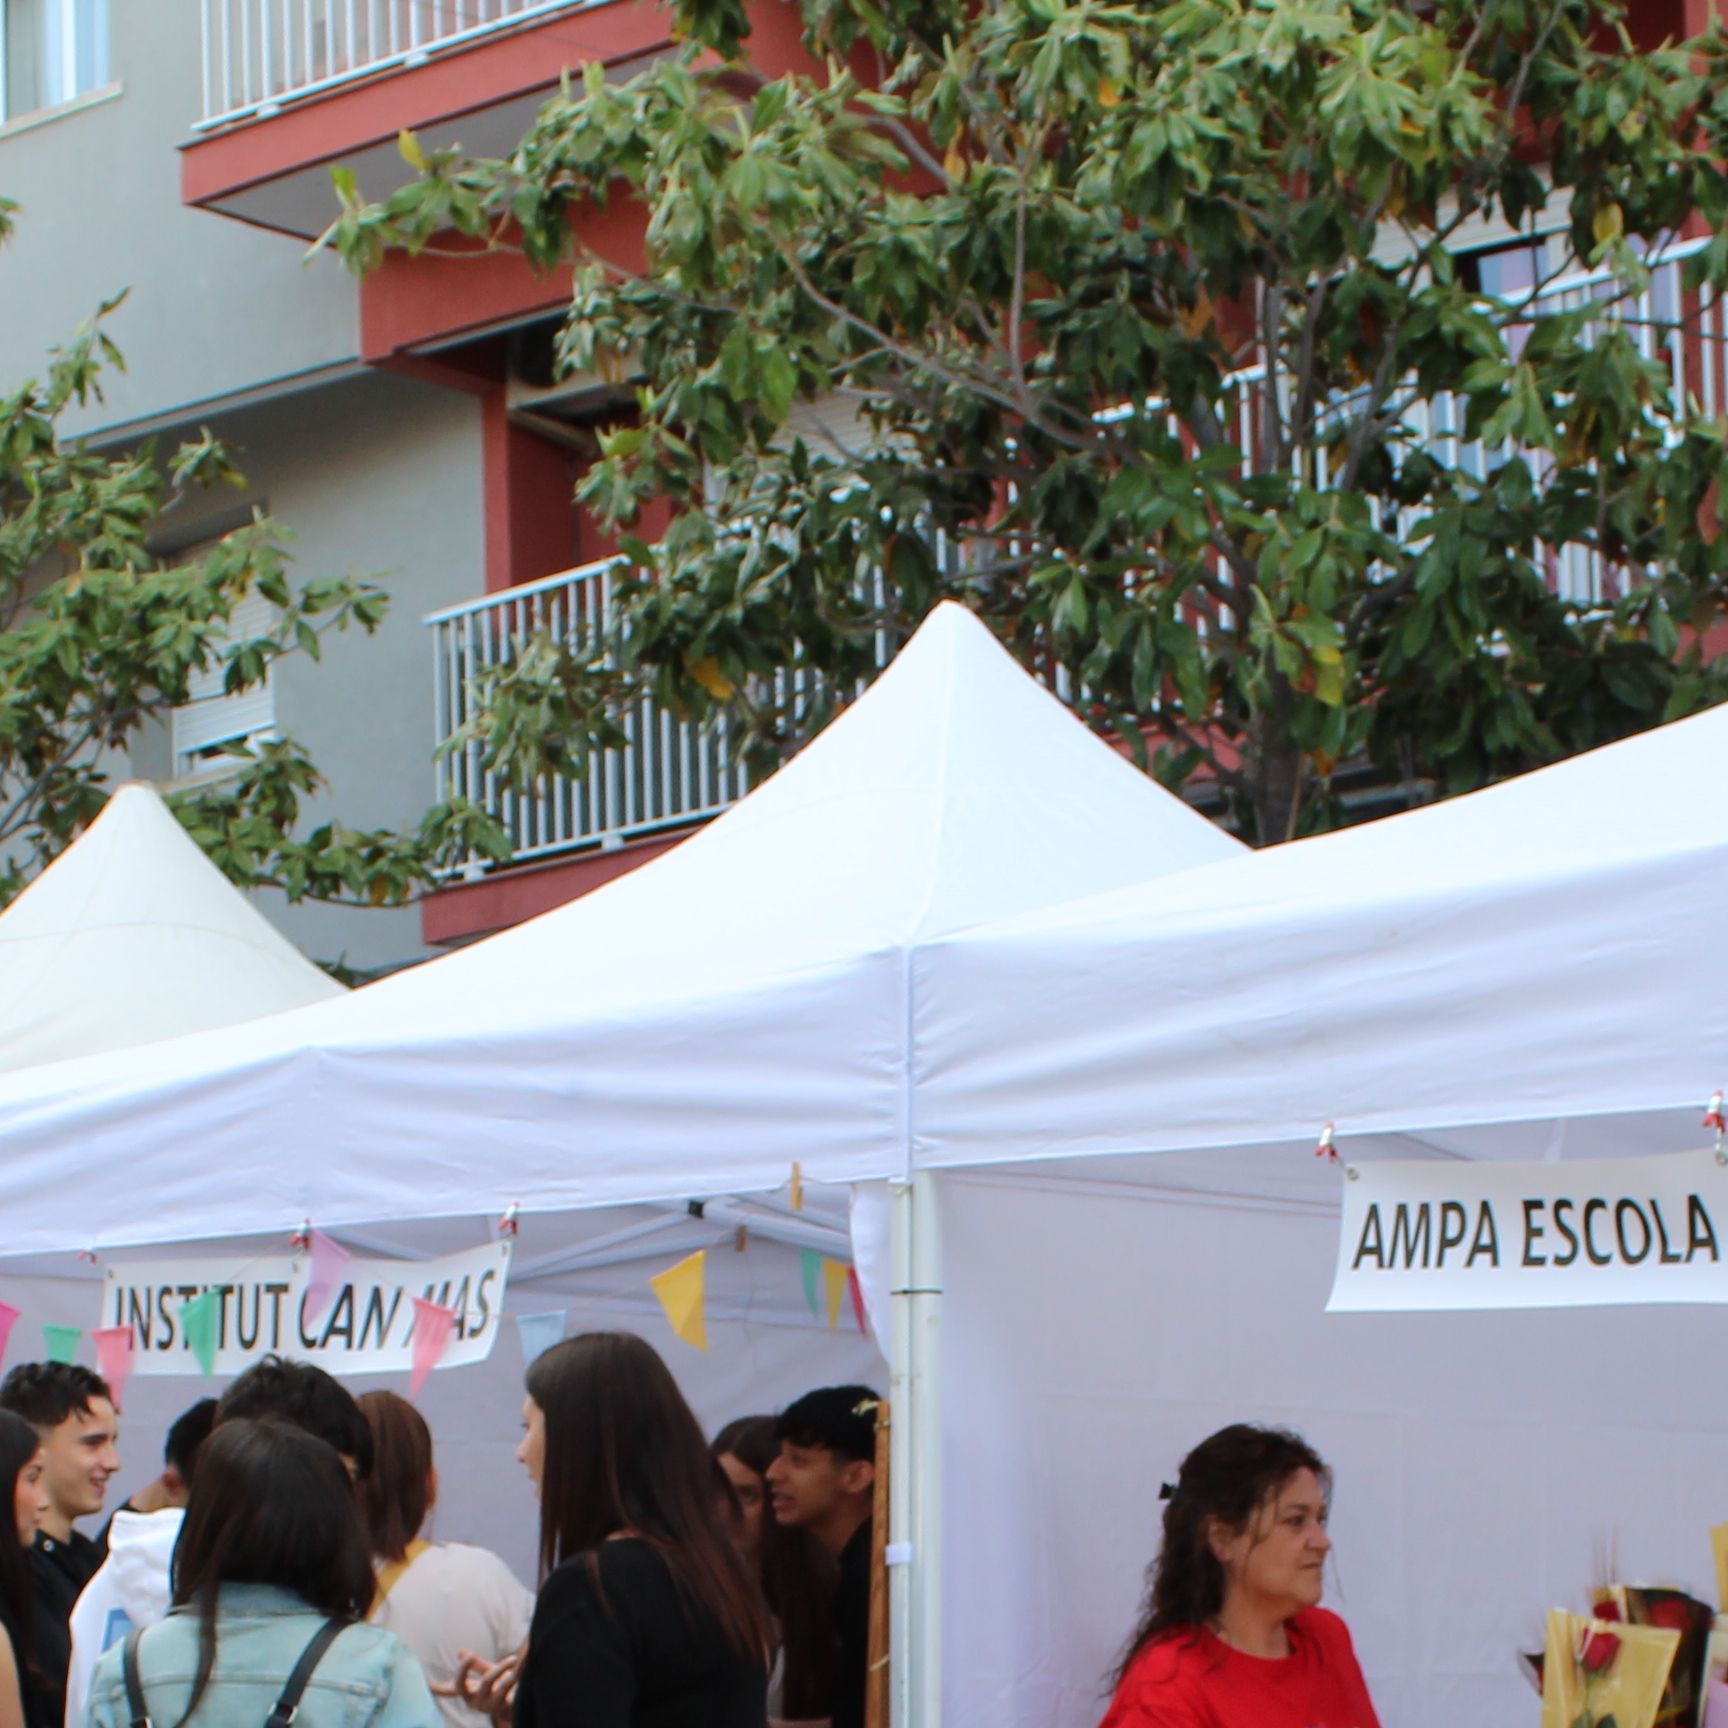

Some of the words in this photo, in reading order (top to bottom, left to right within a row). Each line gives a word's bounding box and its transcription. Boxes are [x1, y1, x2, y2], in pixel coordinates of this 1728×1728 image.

[1352, 1199, 1500, 1271] AMPA
[1521, 1193, 1720, 1268] ESCOLA
[116, 1283, 290, 1352] INSTTUT
